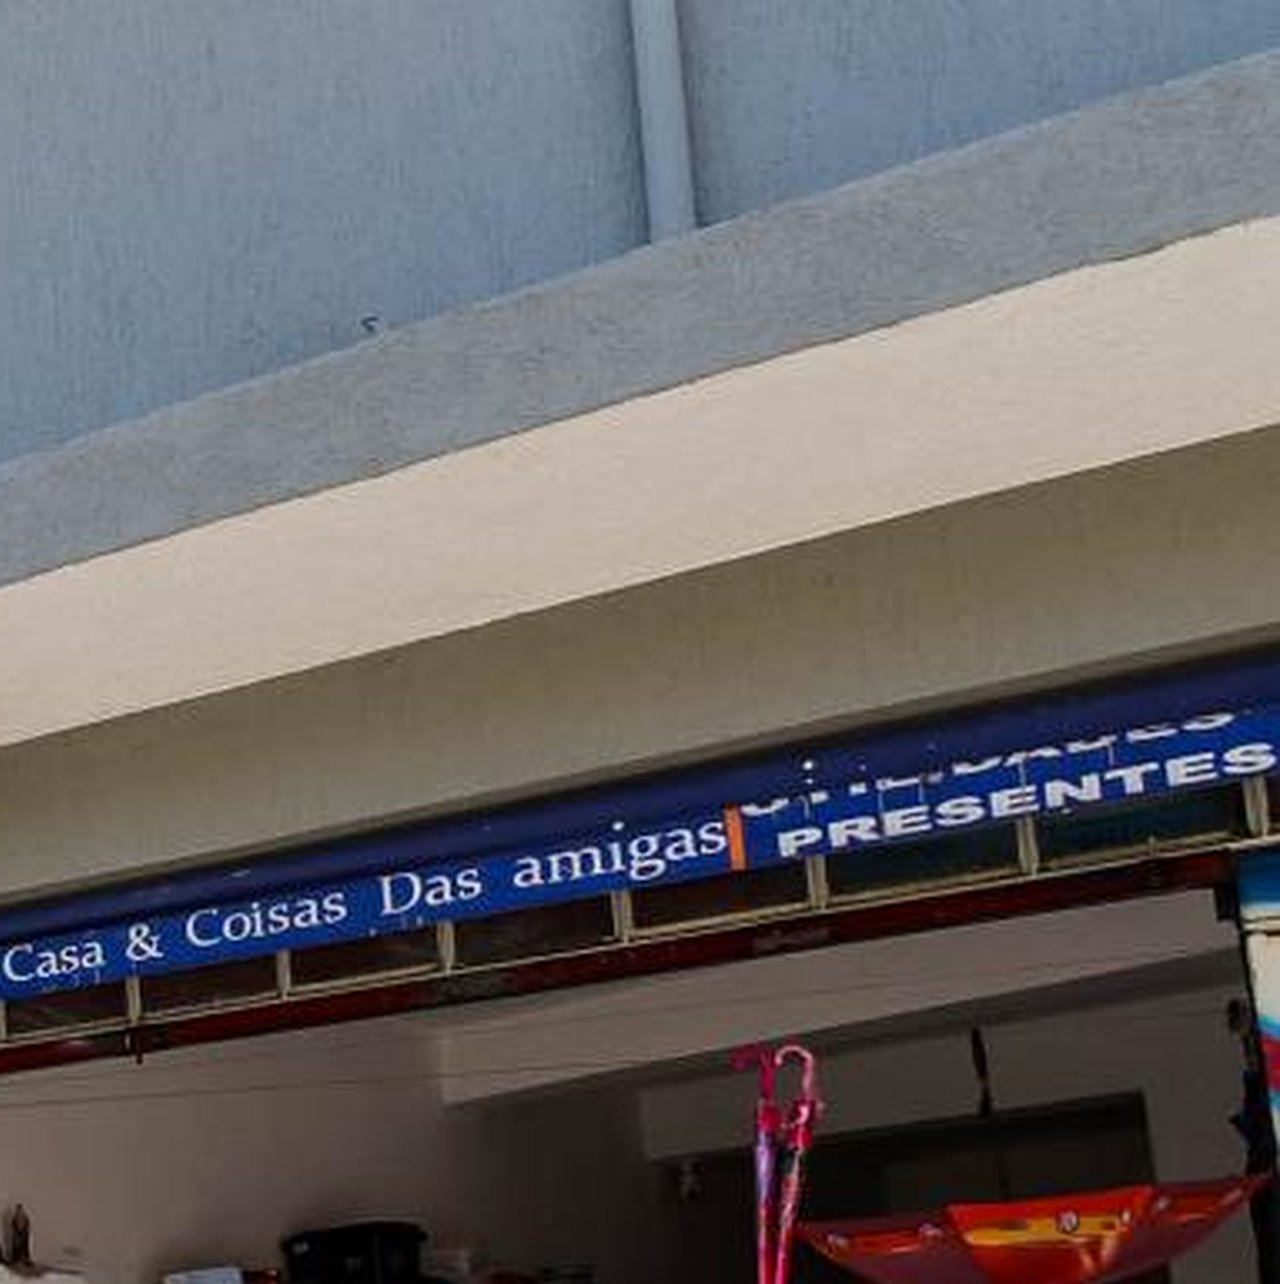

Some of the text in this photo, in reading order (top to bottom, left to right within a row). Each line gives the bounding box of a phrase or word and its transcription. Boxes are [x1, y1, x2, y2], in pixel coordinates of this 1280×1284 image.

[777, 742, 1277, 858] PRESENTES
[2, 817, 729, 983] Casa & Coisas Das amigas
